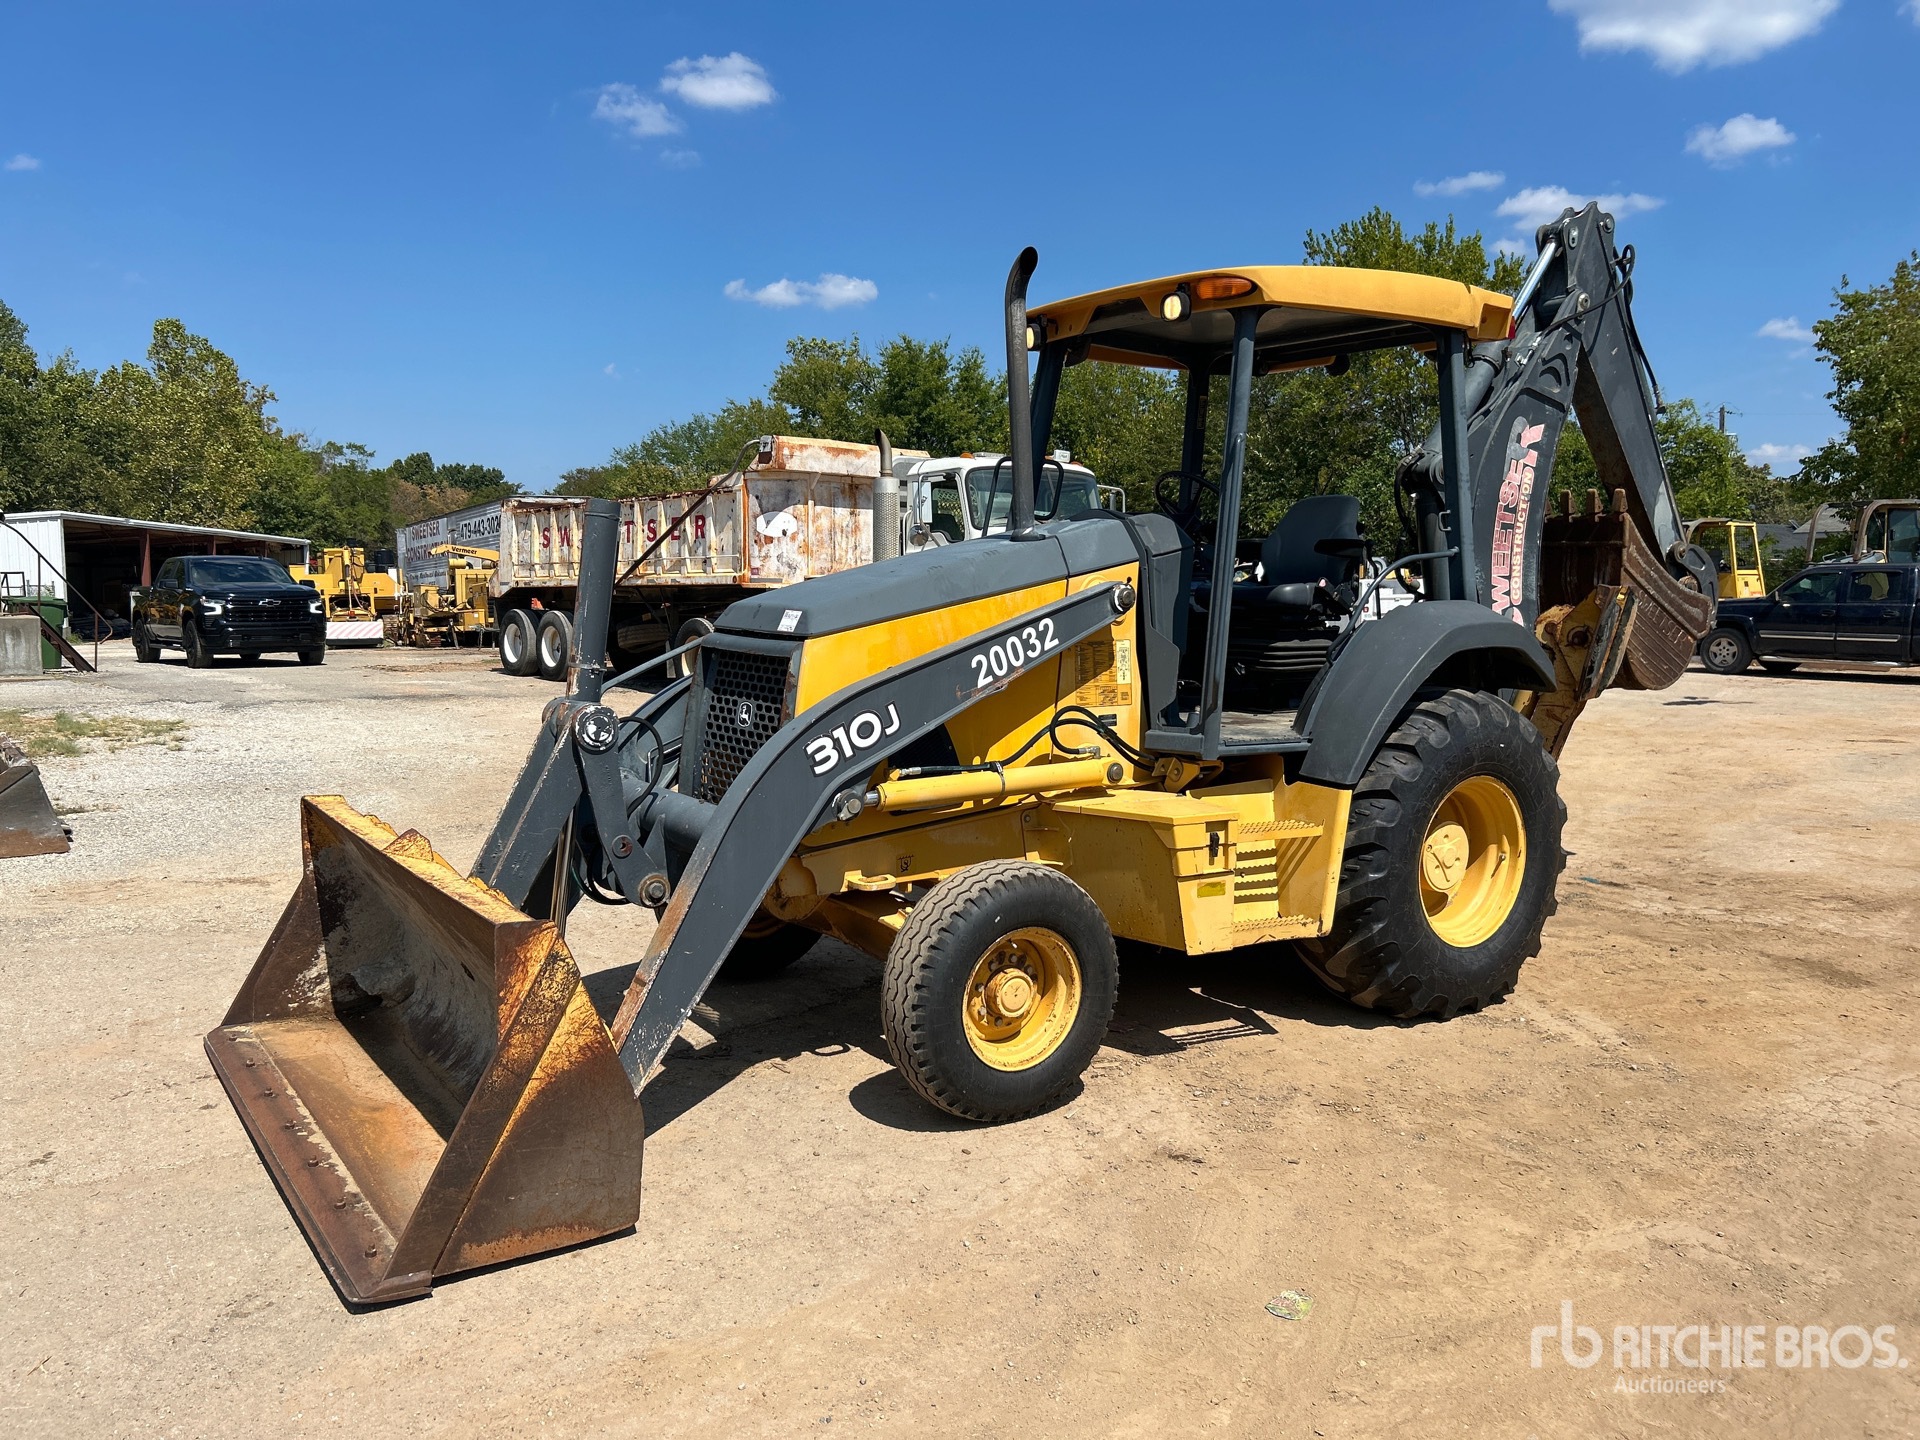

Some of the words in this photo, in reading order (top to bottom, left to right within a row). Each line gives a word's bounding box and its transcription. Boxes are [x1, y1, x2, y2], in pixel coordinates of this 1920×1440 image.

[412, 521, 440, 541] SWEETSER
[451, 545, 478, 555] Vermeer
[971, 617, 1059, 689] 20032
[804, 702, 901, 776] 310J
